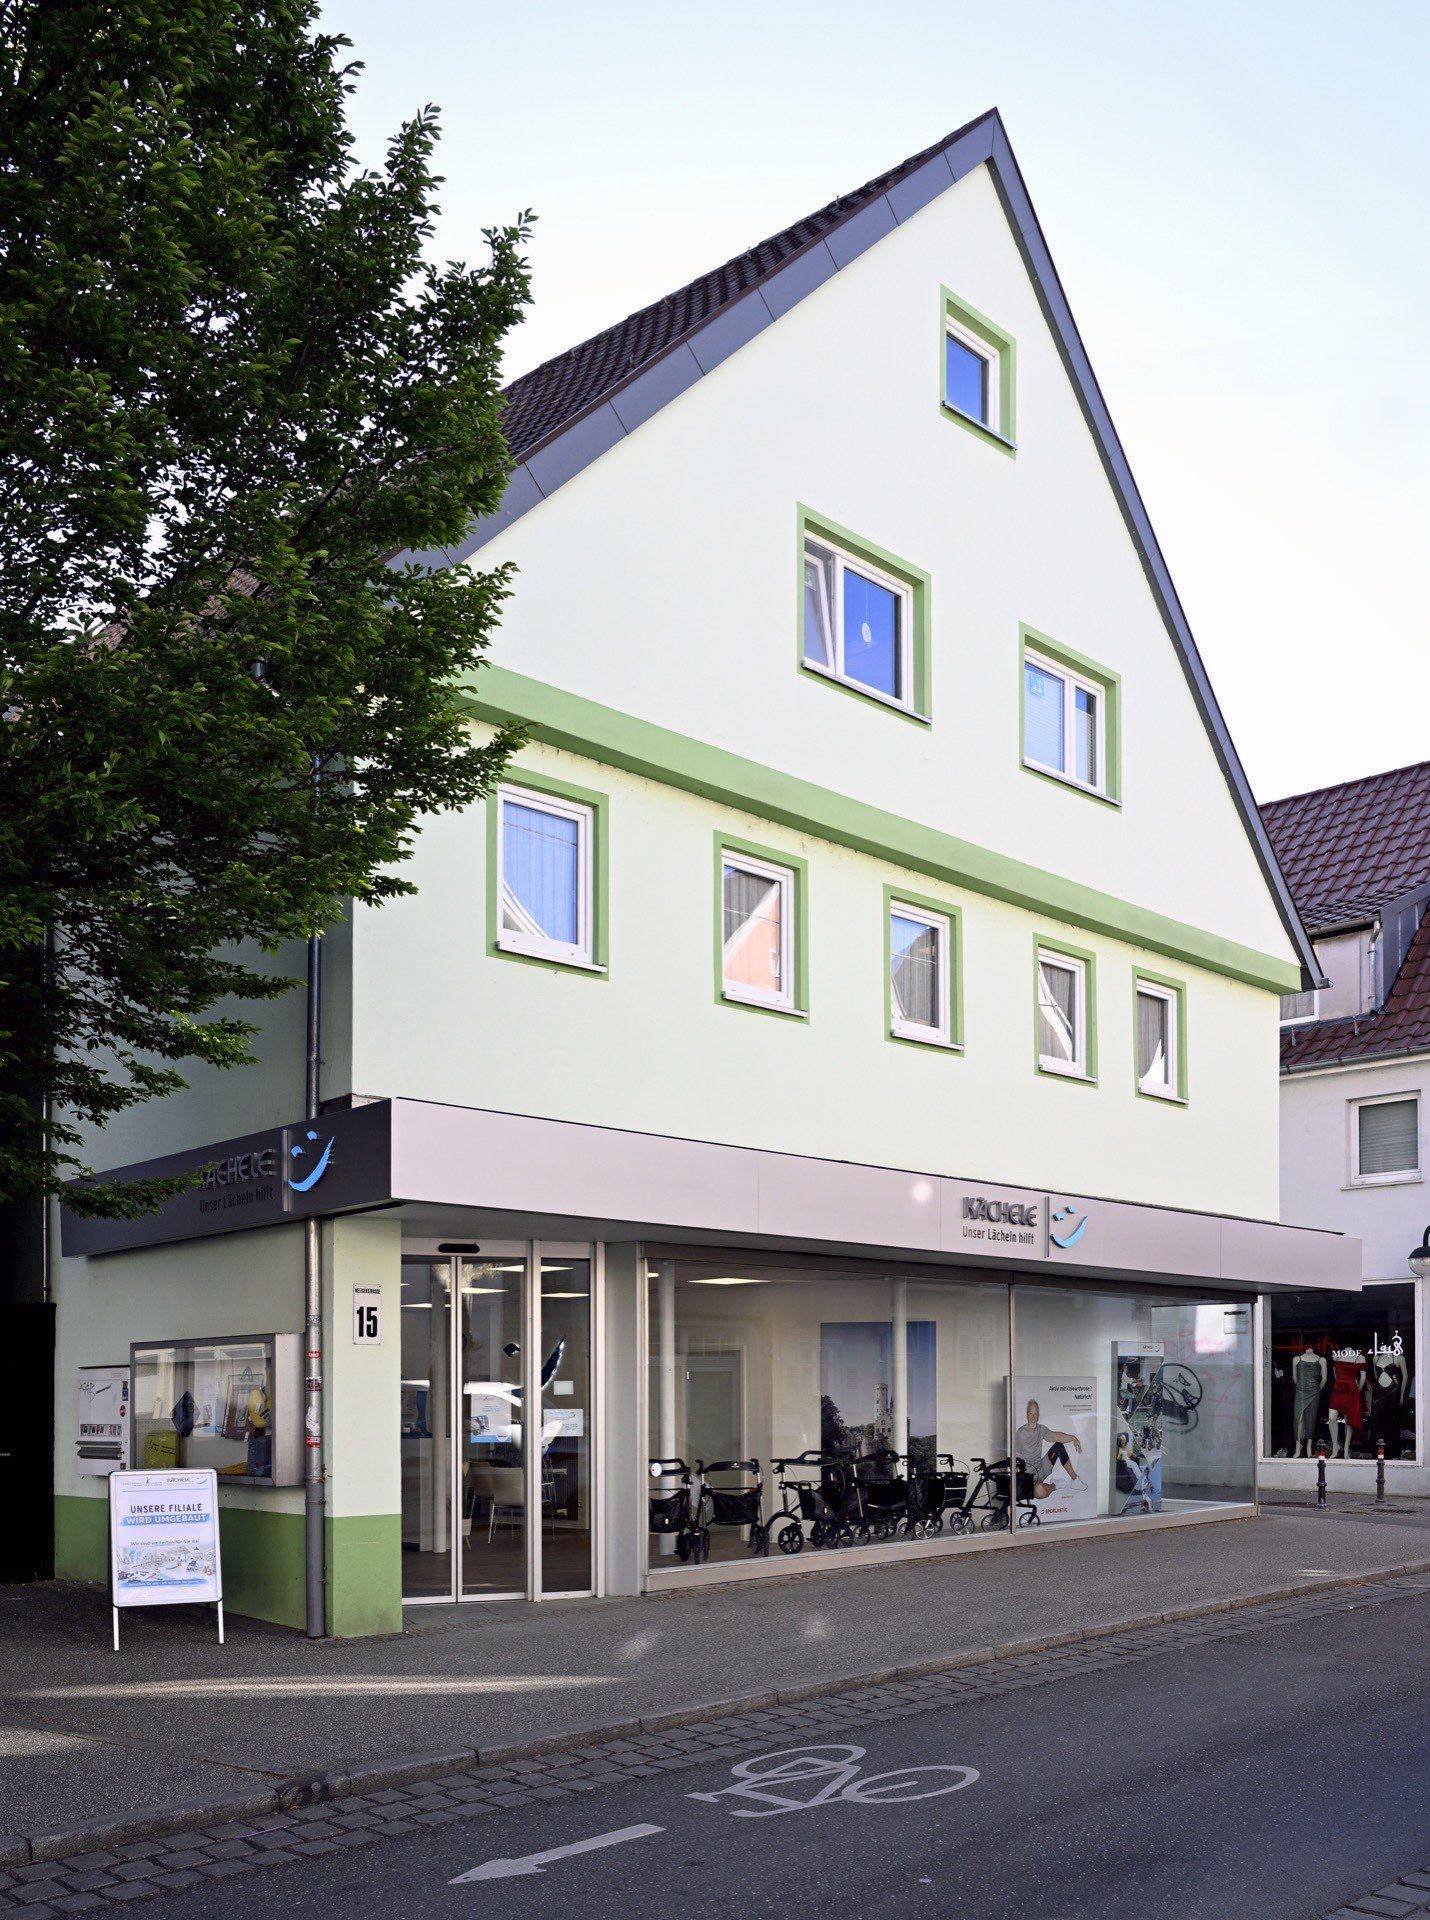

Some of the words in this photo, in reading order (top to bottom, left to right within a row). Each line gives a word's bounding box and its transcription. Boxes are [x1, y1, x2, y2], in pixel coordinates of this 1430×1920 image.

[200, 1198, 221, 1214] Unser
[223, 1190, 254, 1209] Lächeln
[256, 1183, 274, 1203] hilft
[962, 1196, 1038, 1228] KÄCHELE
[962, 1225, 985, 1239] Unser
[987, 1228, 1017, 1243] Lächeln
[1018, 1231, 1035, 1245] hilft
[356, 1306, 378, 1338] 15
[1331, 1349, 1362, 1358] MODE
[130, 1504, 166, 1514] UNSERE
[168, 1502, 203, 1512] FILIALE
[126, 1516, 152, 1526] WIRD
[154, 1514, 207, 1524] UMGEBAUT
